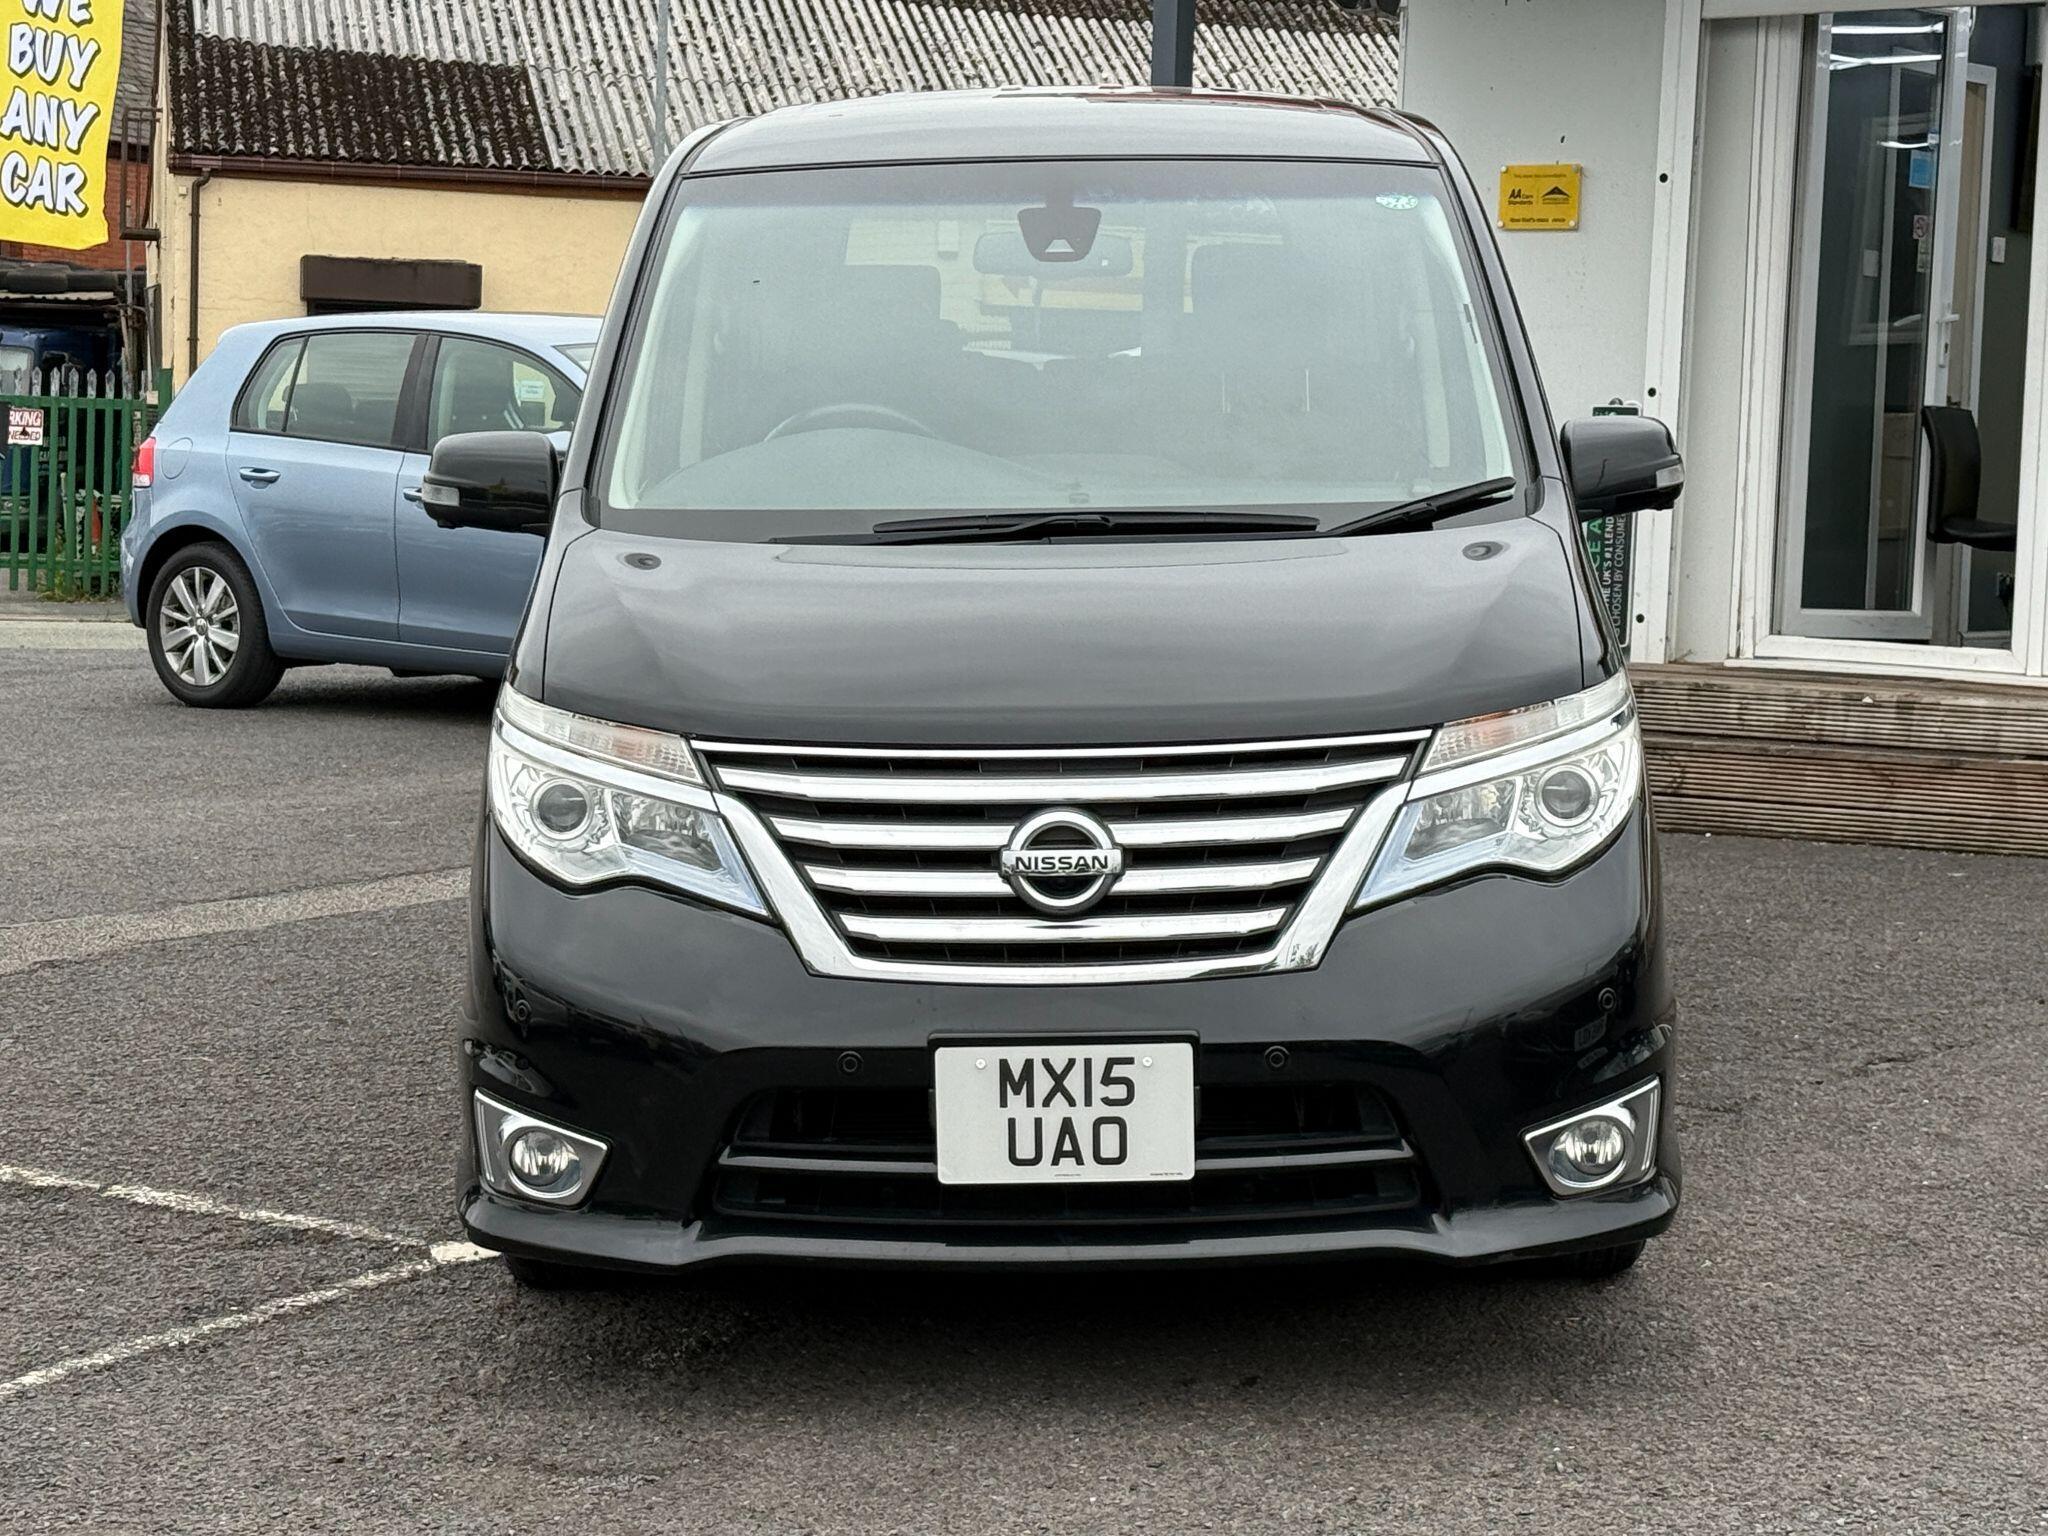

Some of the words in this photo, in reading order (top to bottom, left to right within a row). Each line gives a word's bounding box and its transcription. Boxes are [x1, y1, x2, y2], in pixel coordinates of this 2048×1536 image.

[8, 22, 101, 92] BUY
[0, 86, 101, 155] ANY
[0, 150, 89, 218] CAR
[1613, 513, 1626, 568] CONSUME
[1602, 560, 1613, 585] UK'S
[1613, 569, 1624, 581] BY
[1611, 584, 1622, 627] CHOSEN
[1015, 855, 1108, 870] NISSAN
[999, 1057, 1135, 1108] MX15
[1007, 1116, 1129, 1166] UAO
